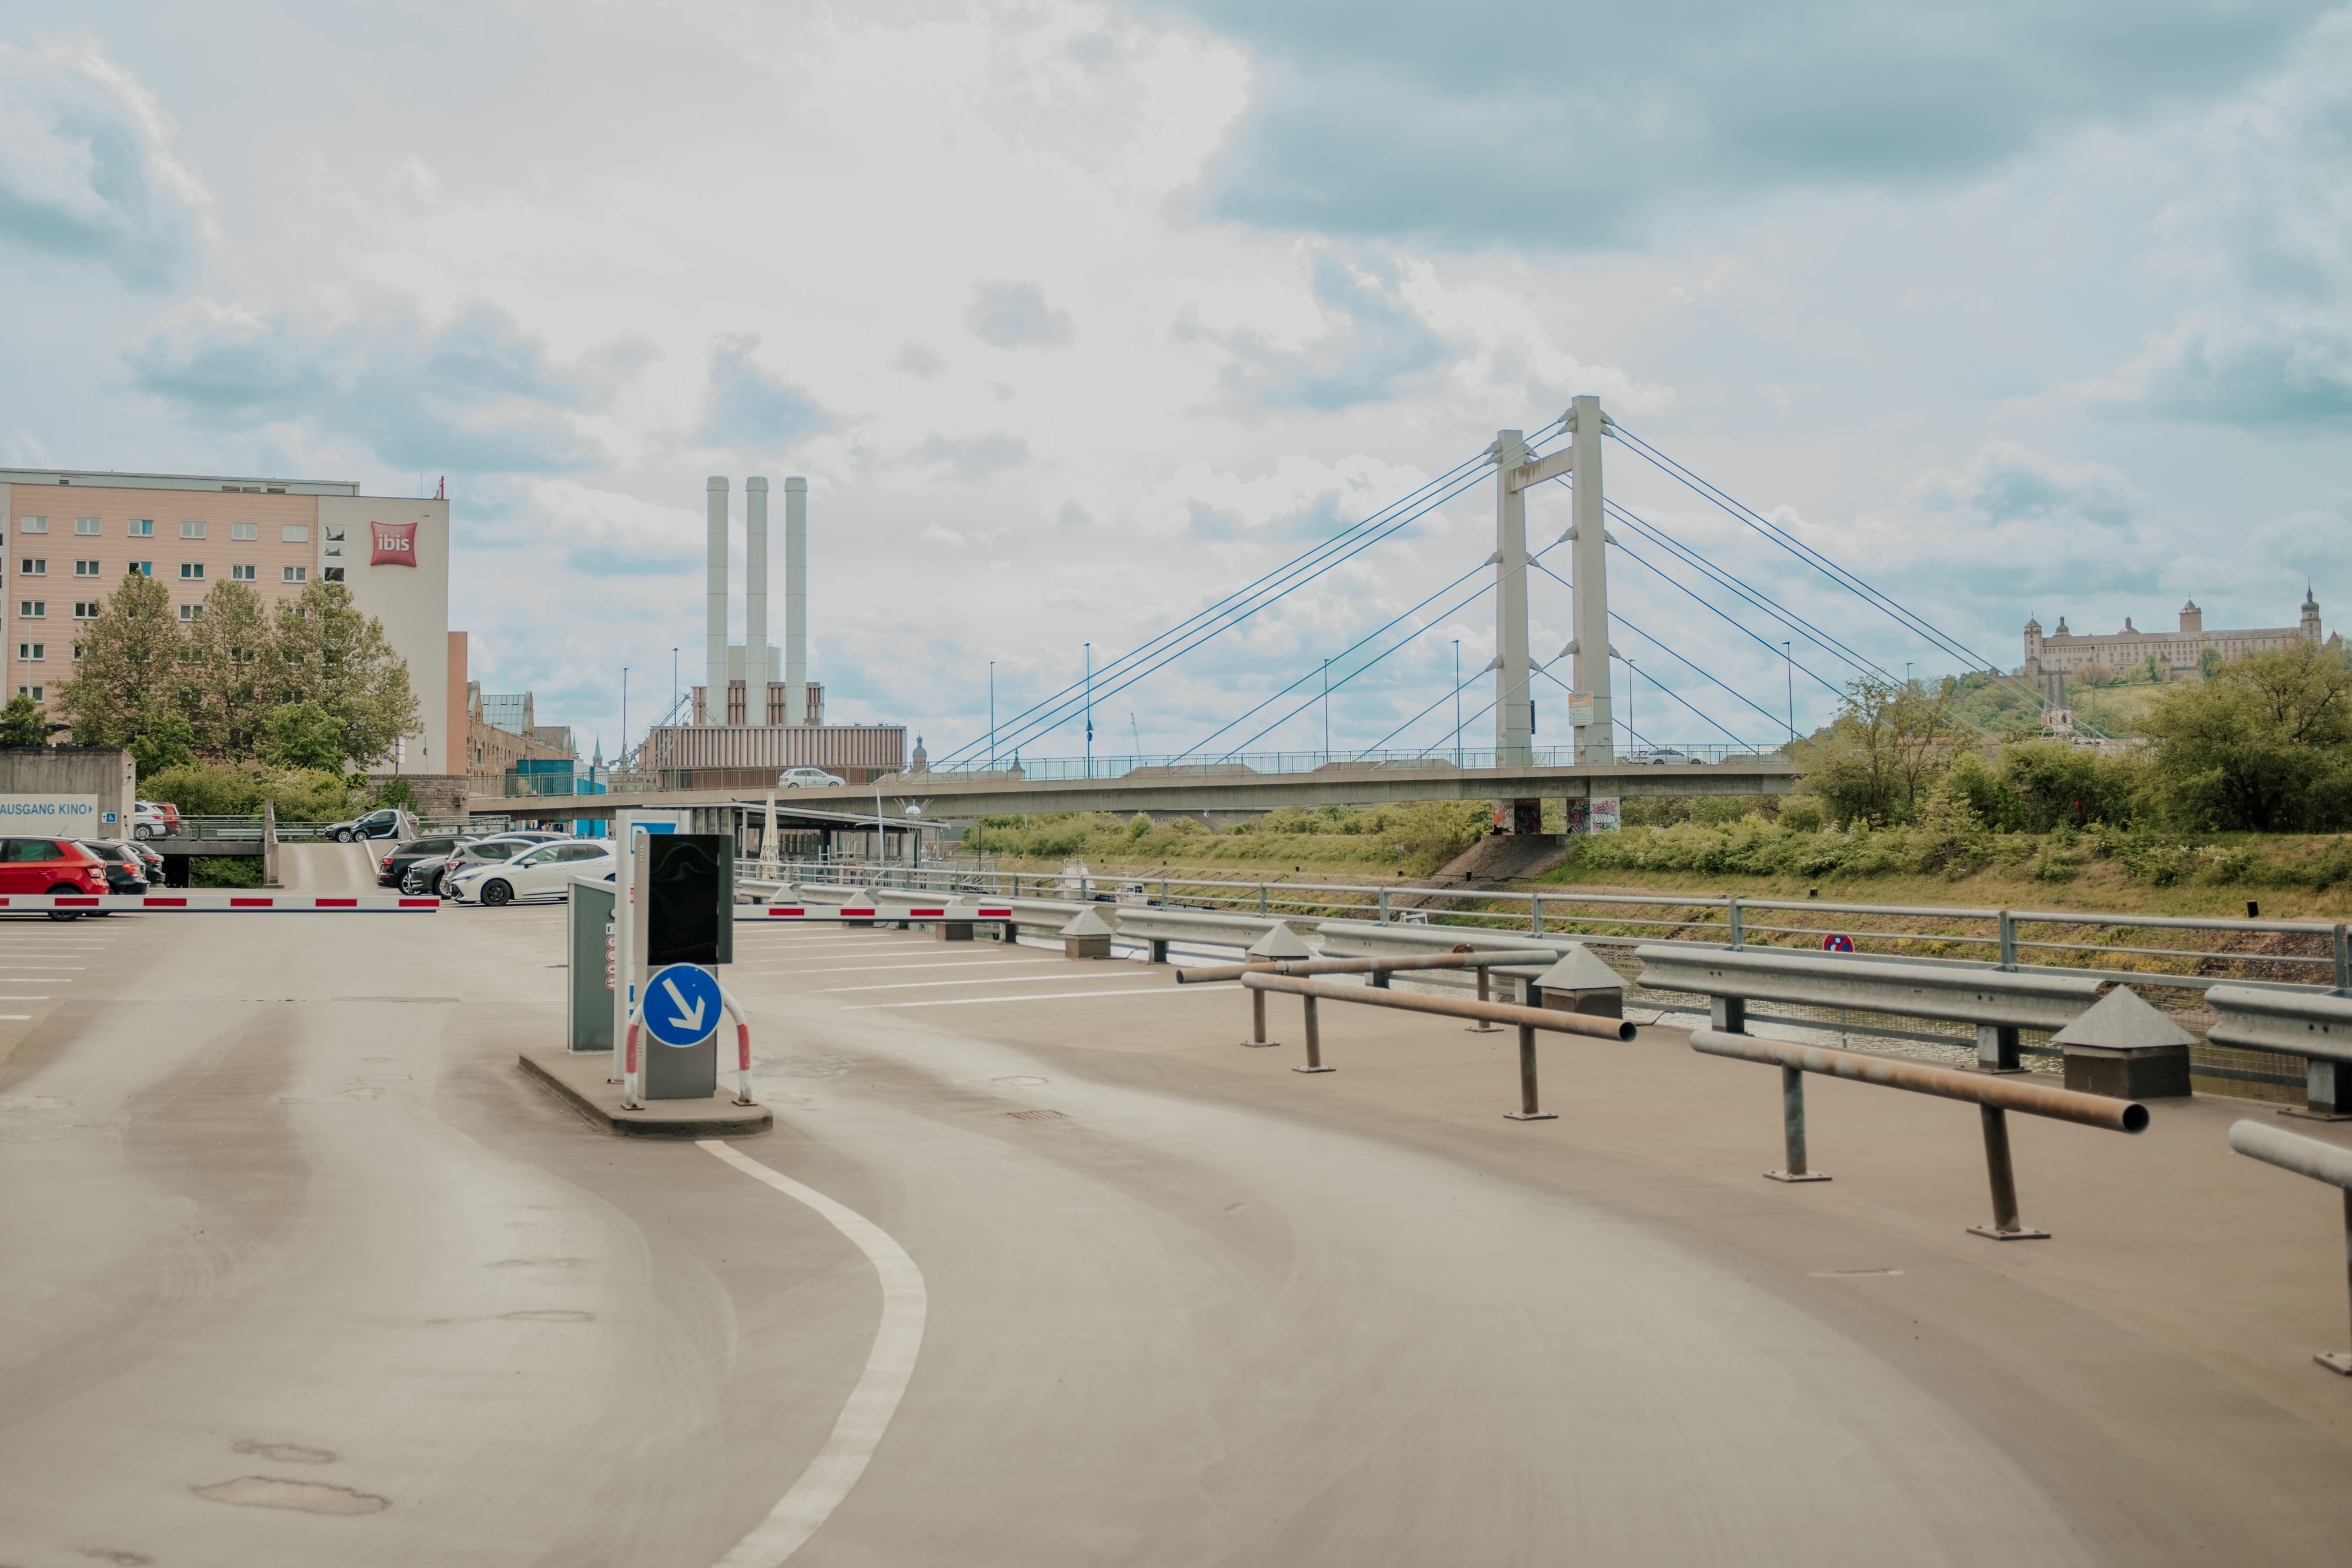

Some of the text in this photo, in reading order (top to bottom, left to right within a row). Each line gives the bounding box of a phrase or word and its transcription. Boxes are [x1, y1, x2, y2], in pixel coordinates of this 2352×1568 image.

[378, 533, 410, 551] ibis
[0, 804, 87, 815] AUSGANG KINO
